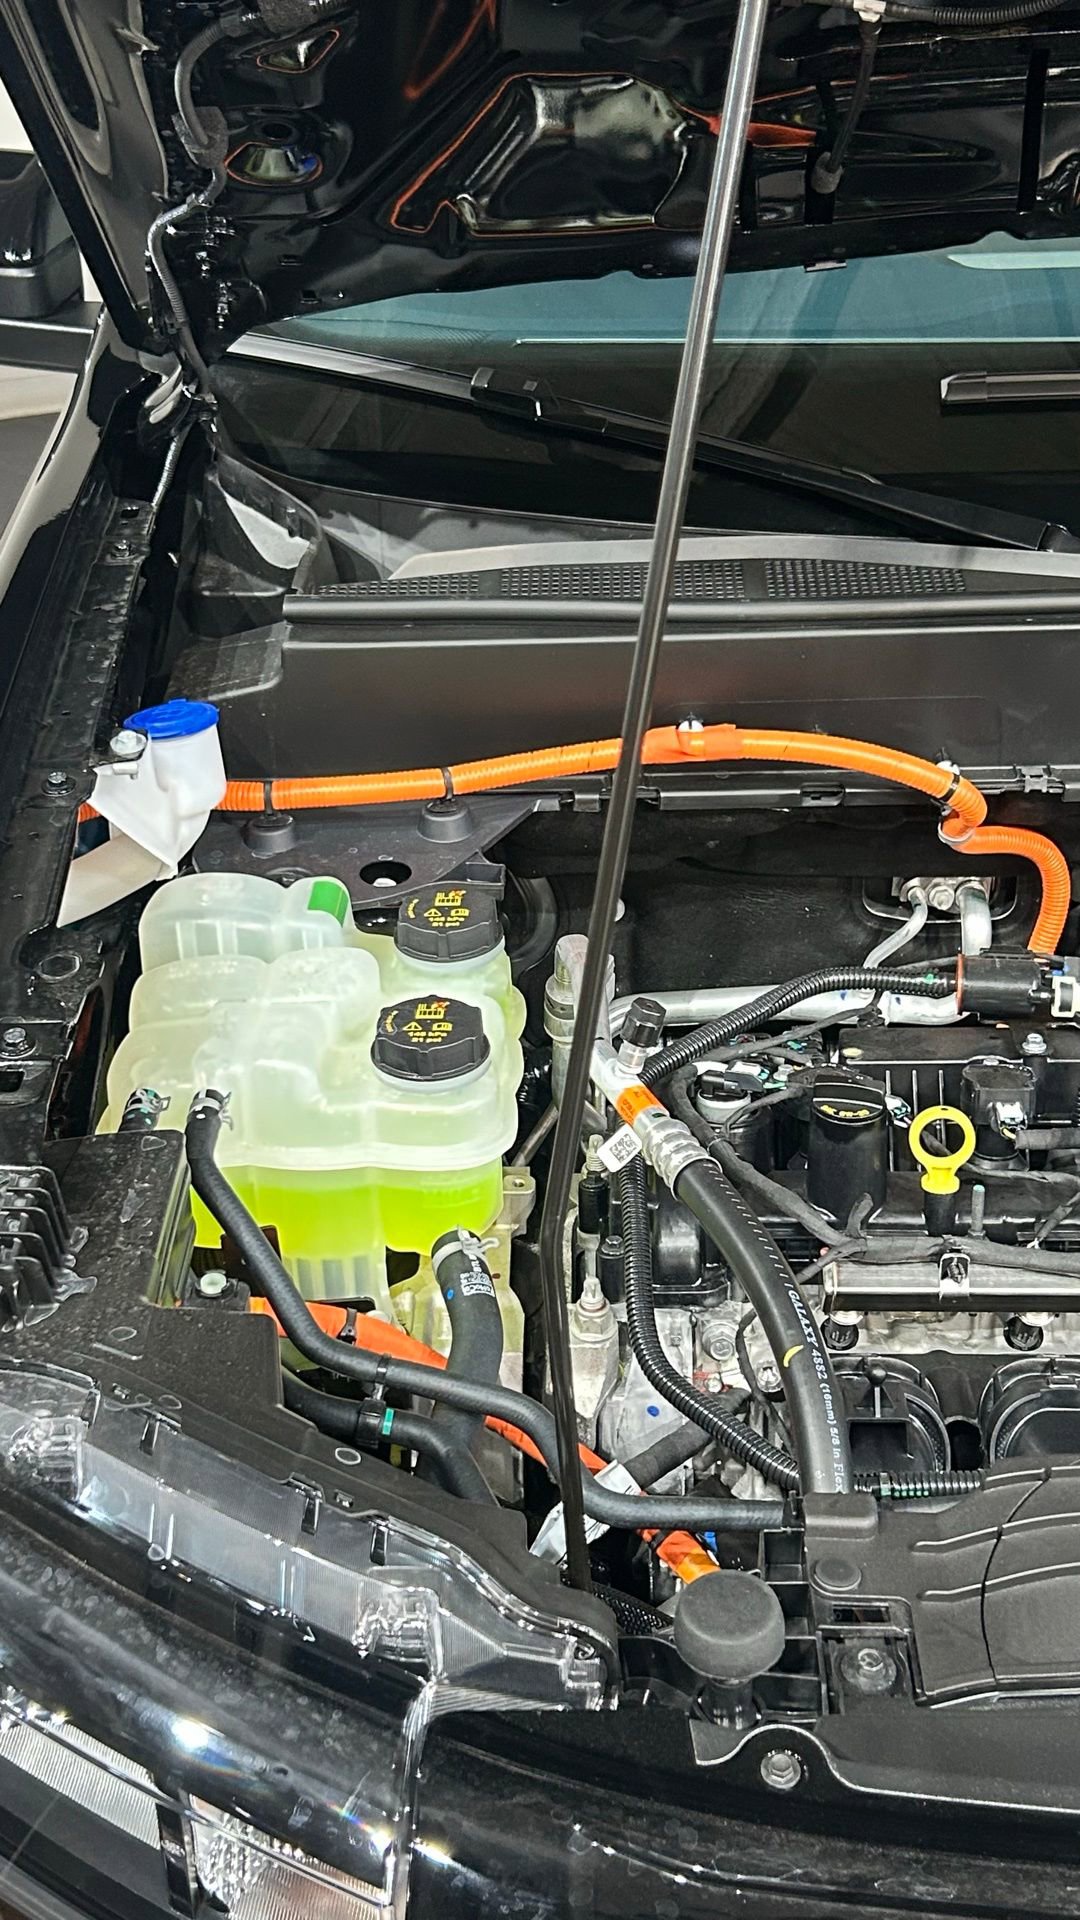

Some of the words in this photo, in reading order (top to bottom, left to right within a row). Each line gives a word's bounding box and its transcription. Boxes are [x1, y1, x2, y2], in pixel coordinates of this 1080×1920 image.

[788, 1290, 819, 1347] GALAXY
[819, 1383, 837, 1425] (16mm)
[830, 1427, 841, 1445] 5/8
